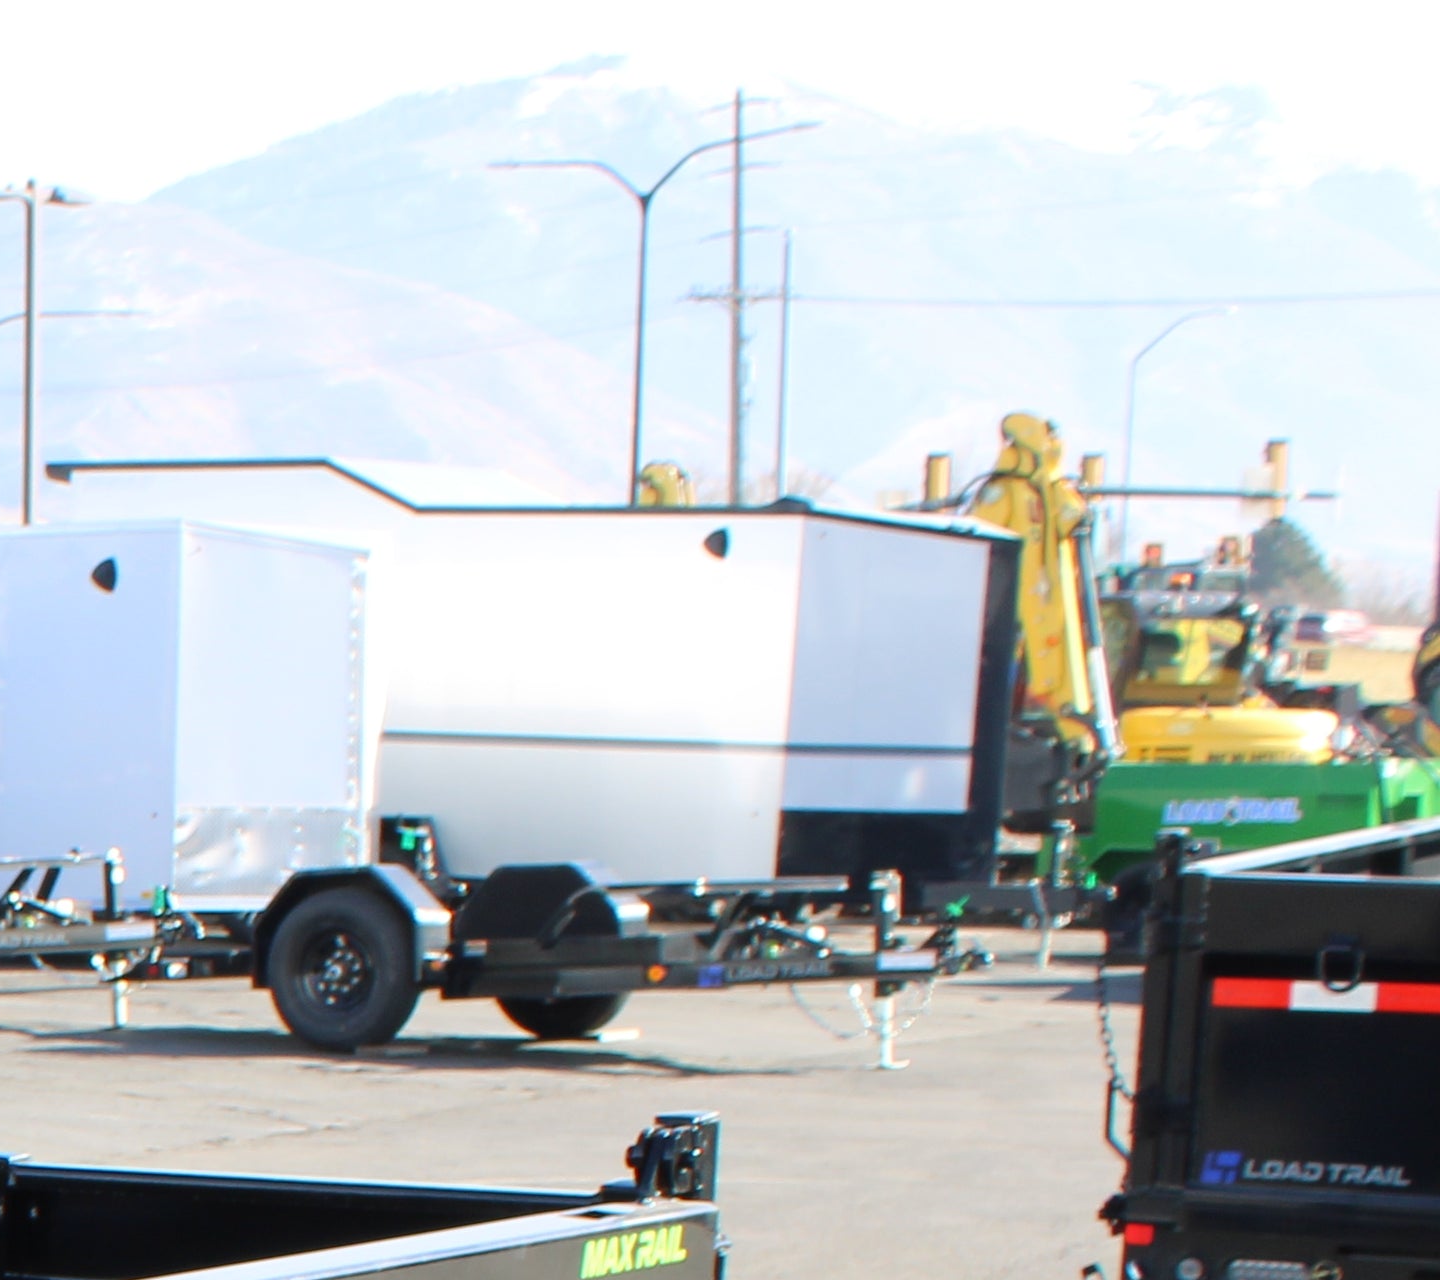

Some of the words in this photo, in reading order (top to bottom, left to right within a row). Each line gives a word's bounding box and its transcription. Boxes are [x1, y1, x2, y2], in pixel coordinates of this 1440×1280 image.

[1242, 1158, 1323, 1182] LOAD
[1327, 1163, 1413, 1187] TRAIL
[581, 1233, 637, 1279] MAX
[636, 1224, 688, 1269] RAIL
